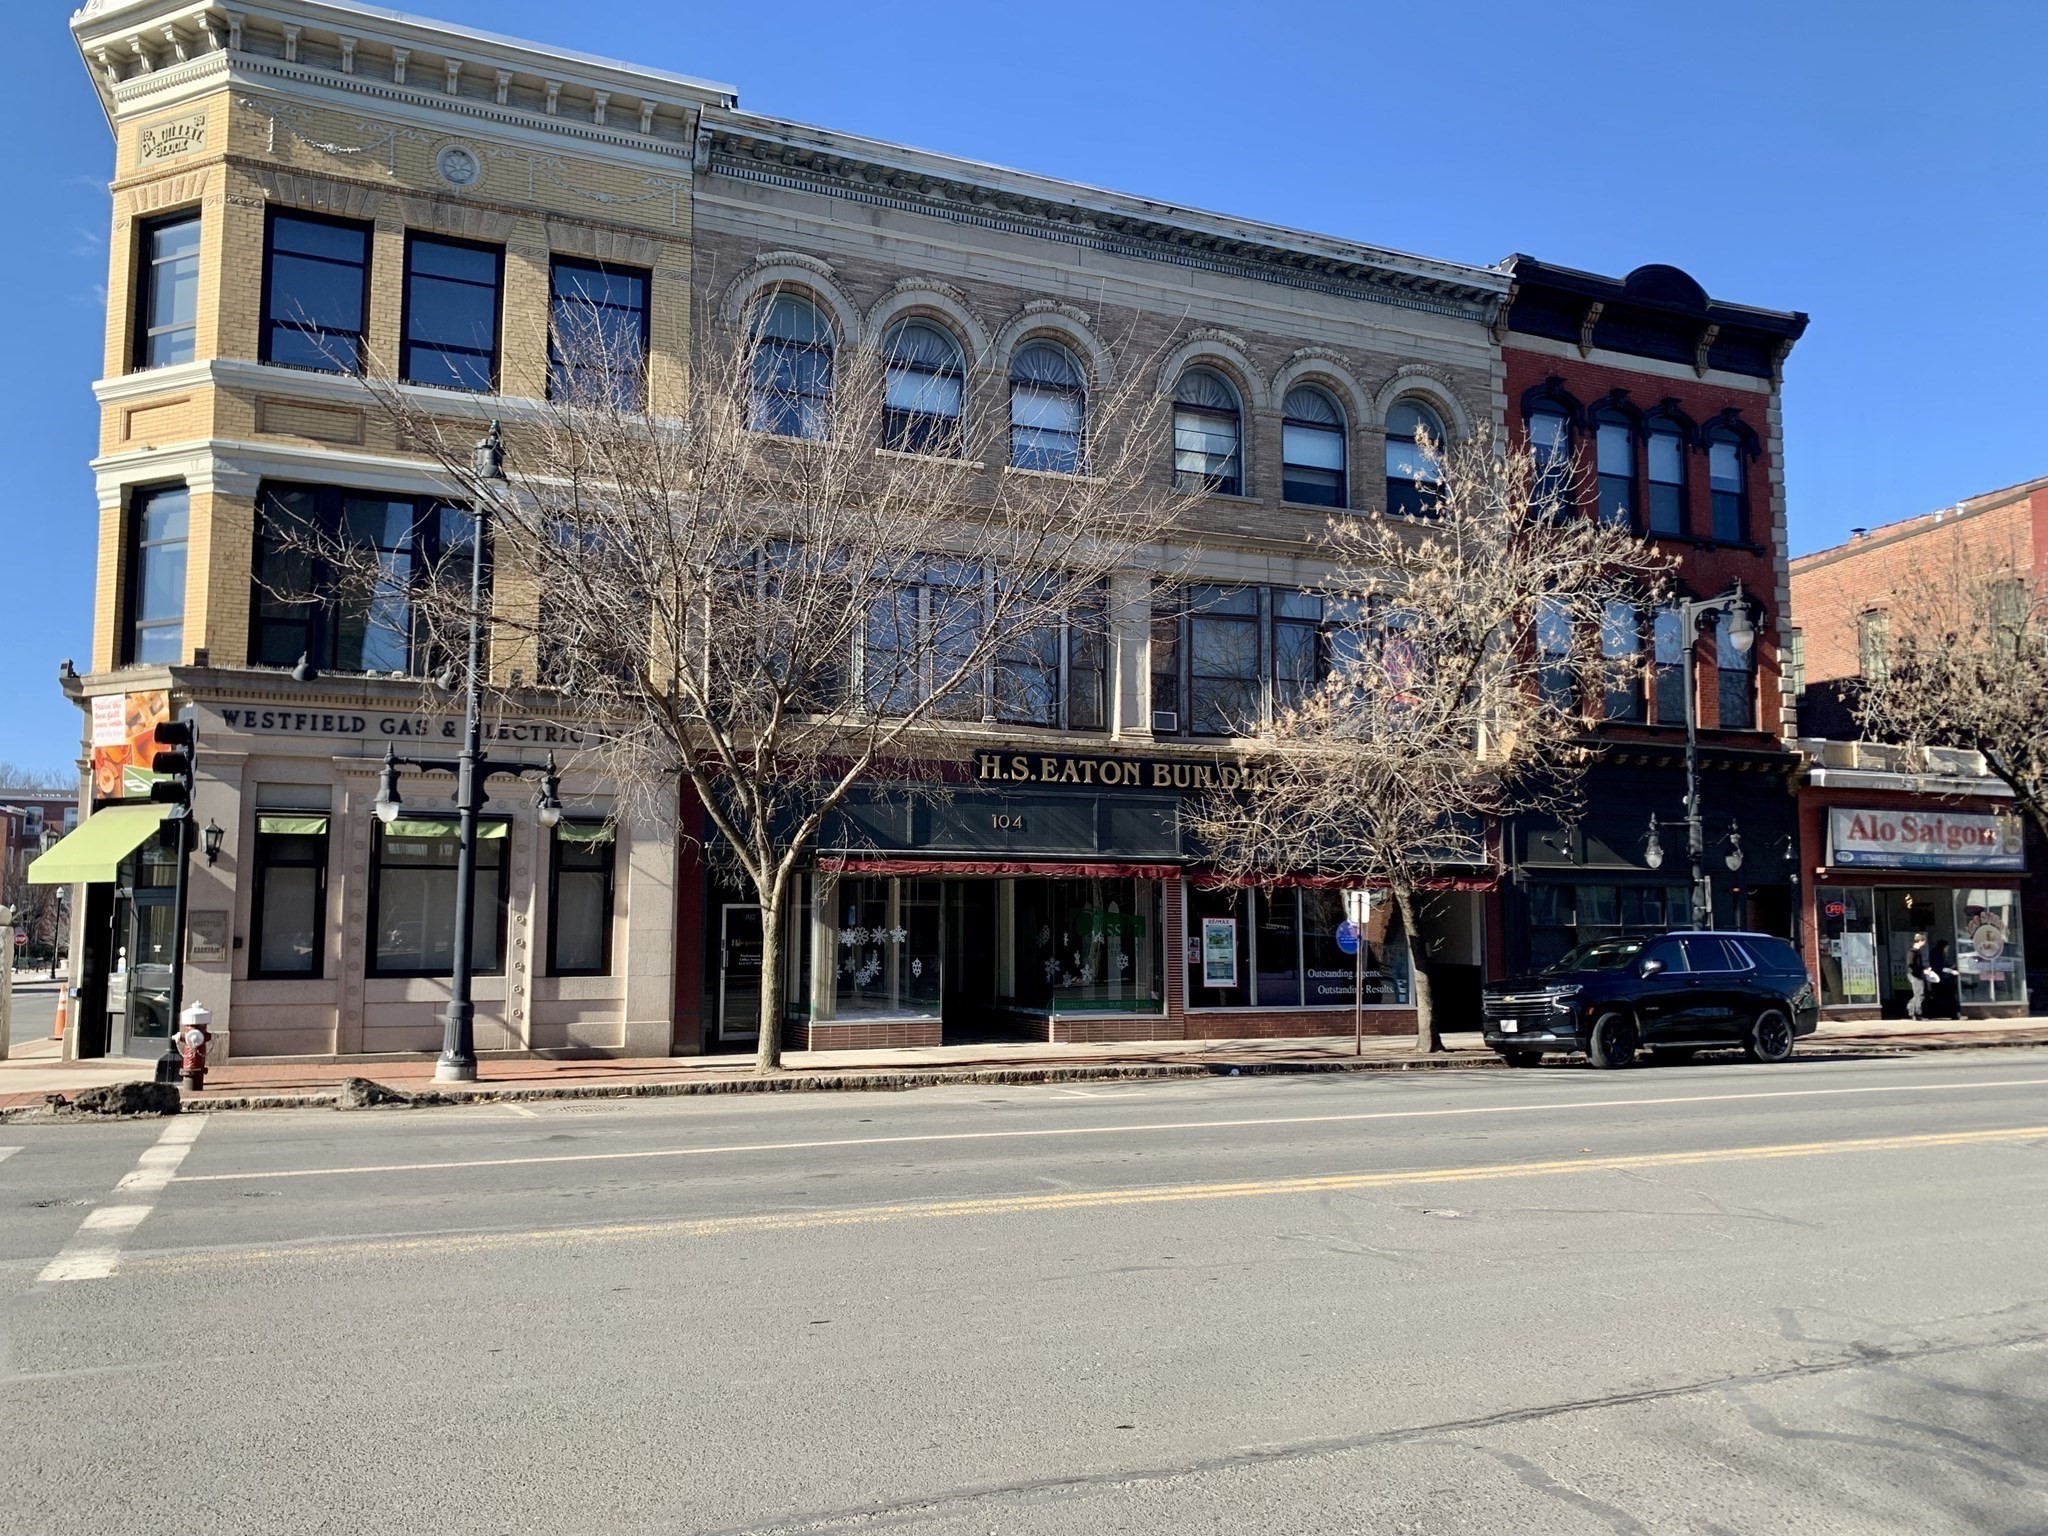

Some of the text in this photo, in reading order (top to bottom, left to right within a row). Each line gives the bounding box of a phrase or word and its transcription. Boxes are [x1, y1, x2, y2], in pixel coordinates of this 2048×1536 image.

[156, 139, 188, 158] BLOCK
[222, 709, 365, 732] WESTFIELD
[380, 718, 428, 735] GAS
[442, 721, 456, 737] &
[484, 723, 584, 743] LECTRIC
[1152, 763, 1294, 790] BUILDING
[992, 814, 1022, 829] 104
[1847, 813, 1995, 850] Alo Saigon
[1825, 904, 1845, 915] OPEN
[1307, 968, 1383, 980] Outstanding gents.
[1366, 984, 1395, 994] Results.
